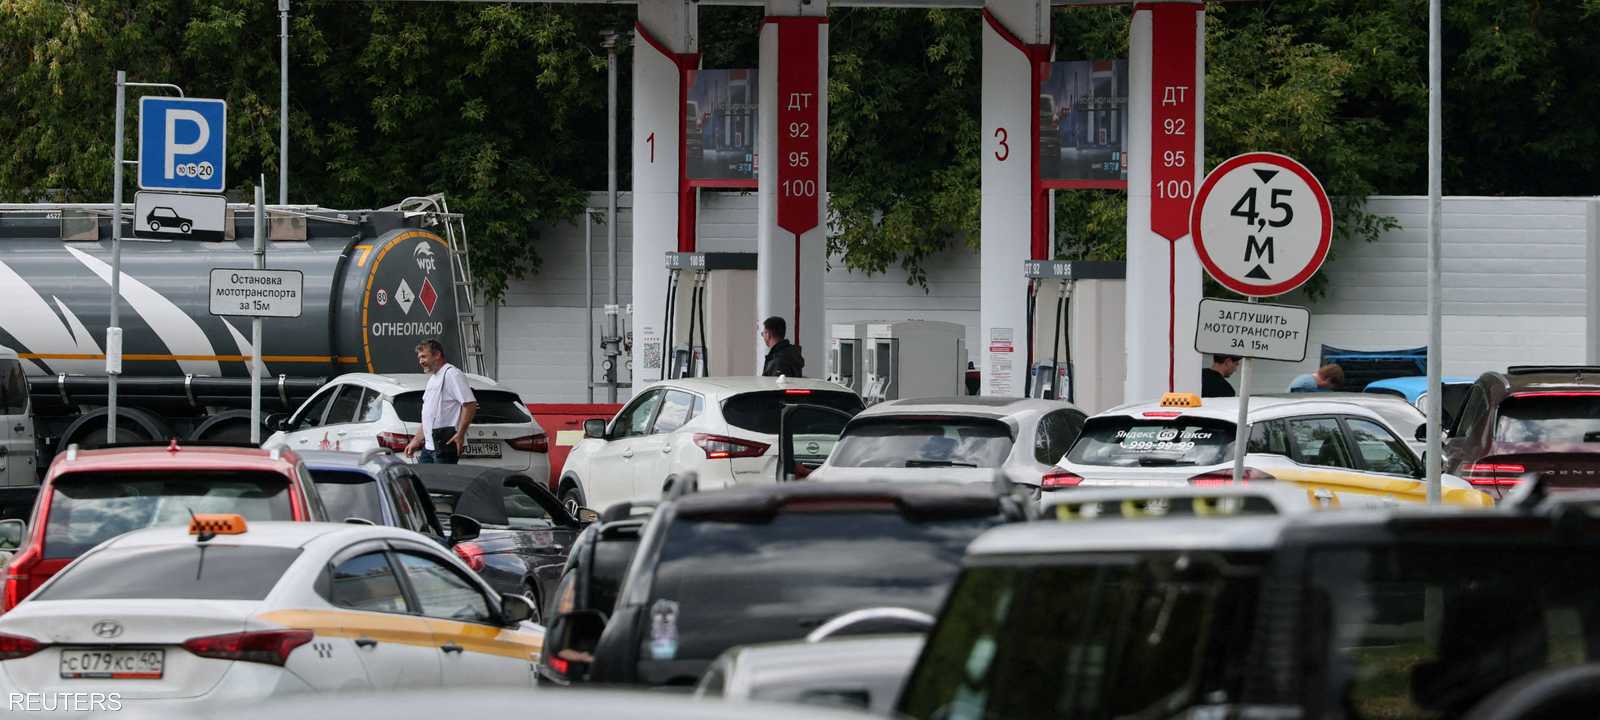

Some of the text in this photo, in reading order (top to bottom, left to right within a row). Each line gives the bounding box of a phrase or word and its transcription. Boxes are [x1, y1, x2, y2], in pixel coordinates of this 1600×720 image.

[788, 93, 812, 110] ДТ
[1163, 87, 1188, 106] ДТ
[789, 122, 809, 138] 92
[1164, 119, 1185, 135] 92
[165, 109, 210, 179] P
[646, 132, 655, 163] 1
[994, 128, 1009, 161] 3
[789, 152, 809, 167] 95
[1164, 151, 1185, 167] 95
[188, 166, 197, 175] 15
[199, 166, 213, 176] 20
[783, 180, 815, 197] 100
[1156, 180, 1191, 199] 100
[1231, 187, 1293, 232] 4,5
[417, 257, 436, 274] wpt
[1032, 263, 1040, 274] 92
[1053, 263, 1063, 275] 100
[1063, 263, 1072, 275] 95
[231, 273, 282, 285] Остановка
[216, 288, 296, 300] мототранспорта
[239, 300, 270, 311] за 15м
[1218, 310, 1288, 325] ЗАГЛУШИТЬ
[372, 322, 443, 336] ОГНЕОПАСНО
[1204, 322, 1299, 340] МОТОТРАНСПОРТ
[1231, 338, 1269, 351] ЗА 15м
[1116, 431, 1155, 439] Яндекс
[1179, 431, 1212, 440] Такси
[1130, 441, 1195, 450] 999-99-99
[140, 652, 158, 667] 40
